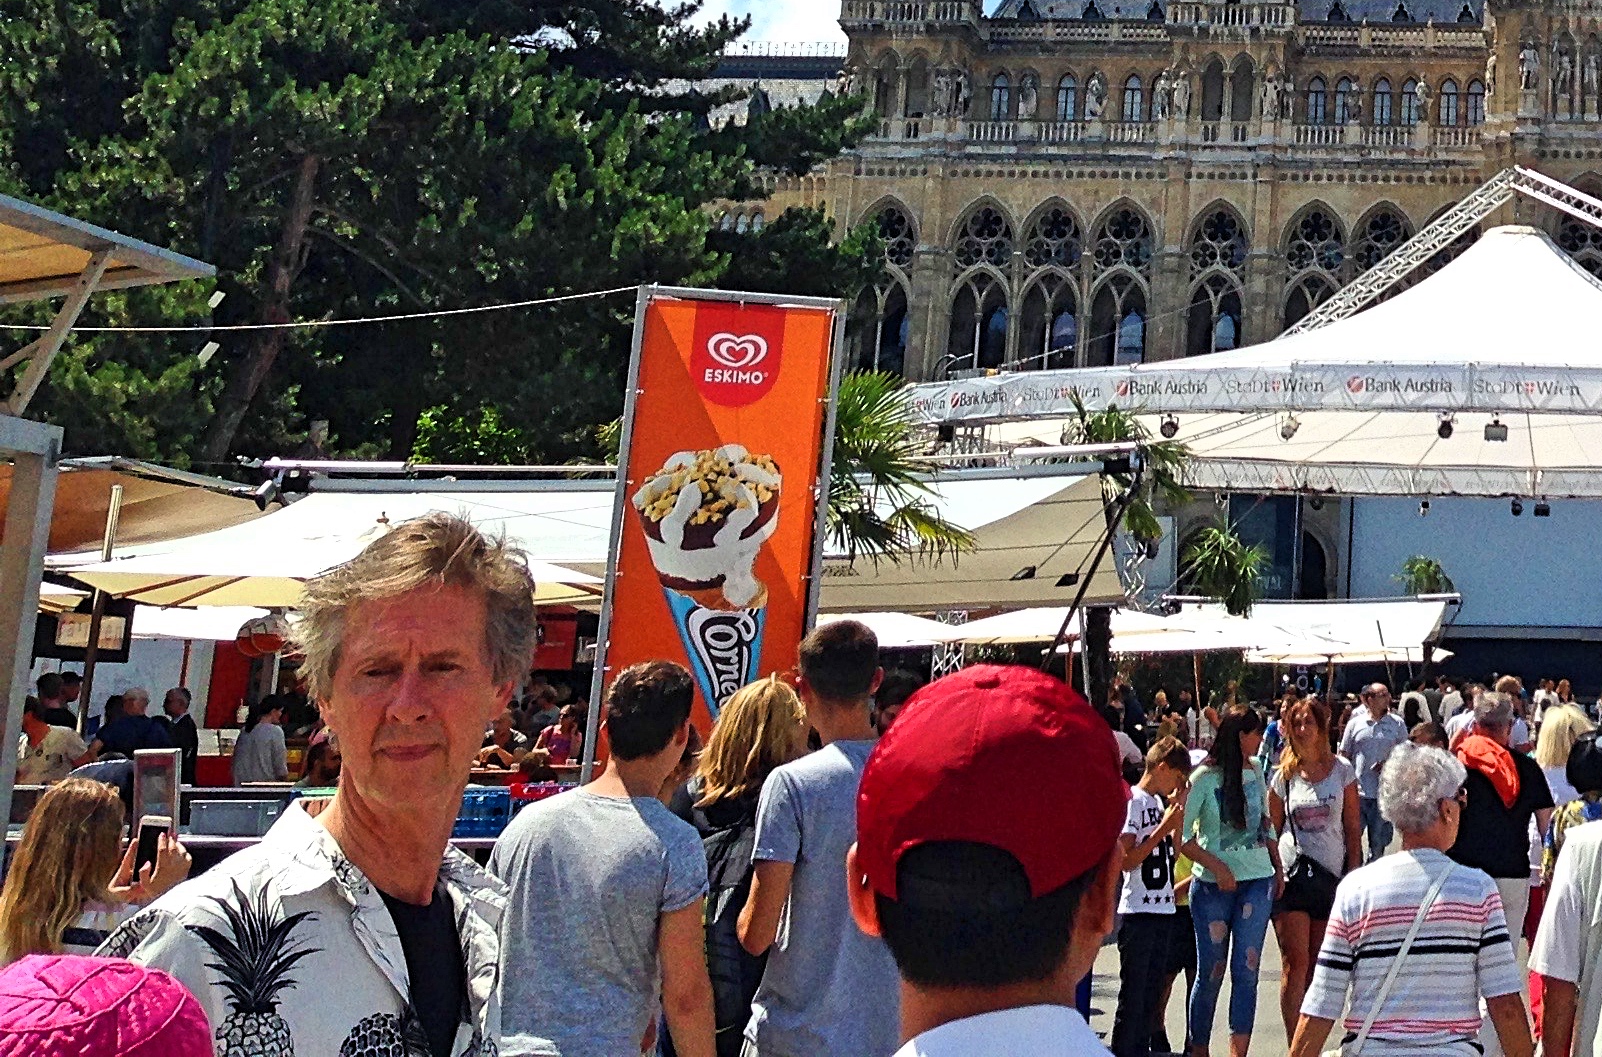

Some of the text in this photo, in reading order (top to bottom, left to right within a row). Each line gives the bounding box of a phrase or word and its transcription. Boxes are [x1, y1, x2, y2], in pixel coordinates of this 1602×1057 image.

[704, 368, 763, 385] ESKIMO
[1129, 380, 1208, 394] Bank Austria
[1283, 378, 1324, 394] Wien
[1365, 377, 1452, 393] Bank Austria
[1536, 380, 1580, 396] Wien
[959, 392, 980, 407] Bank
